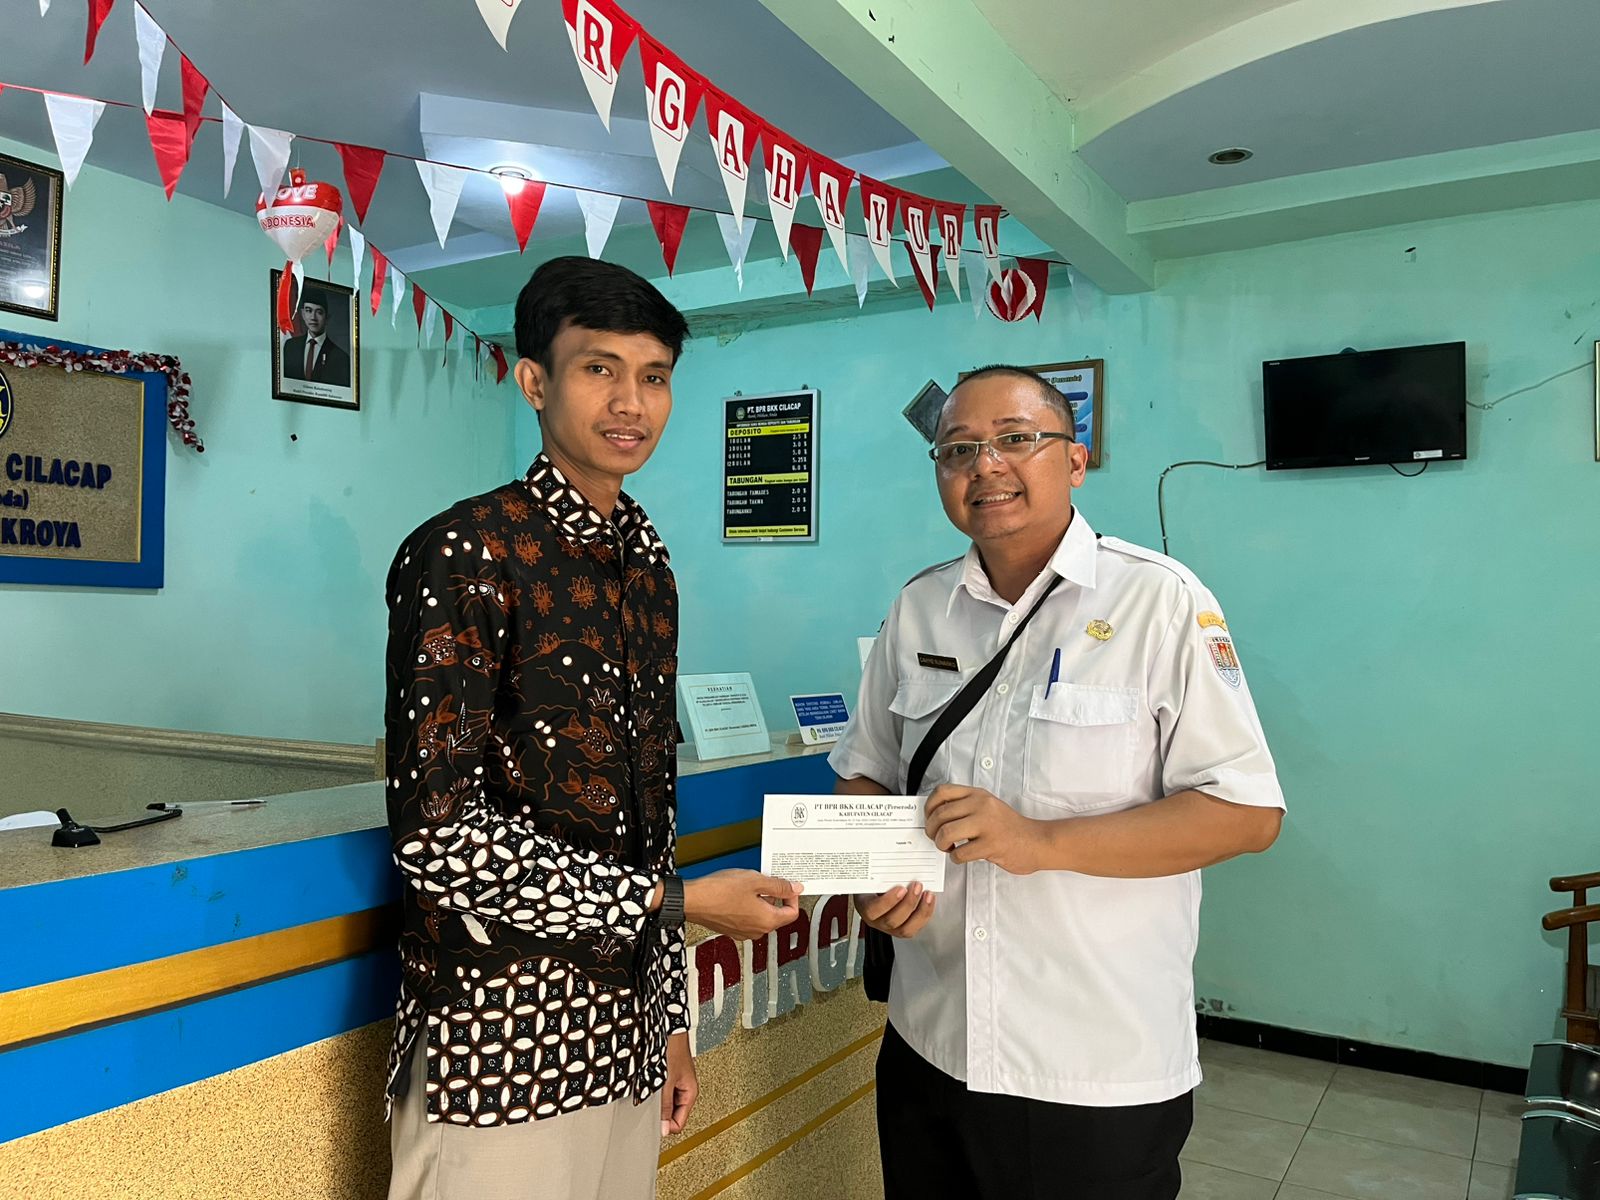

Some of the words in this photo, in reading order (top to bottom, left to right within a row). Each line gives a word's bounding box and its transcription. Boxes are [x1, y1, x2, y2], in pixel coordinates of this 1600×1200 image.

[276, 184, 318, 201] OVE
[755, 405, 766, 413] BPR
[767, 404, 778, 412] BKK
[779, 402, 801, 411] CILACAP
[730, 428, 762, 436] DEPOSITO
[6, 453, 112, 490] CILACAP
[729, 476, 763, 484] TABUNGAN
[0, 489, 29, 510] da)
[1, 517, 81, 548] KROYA
